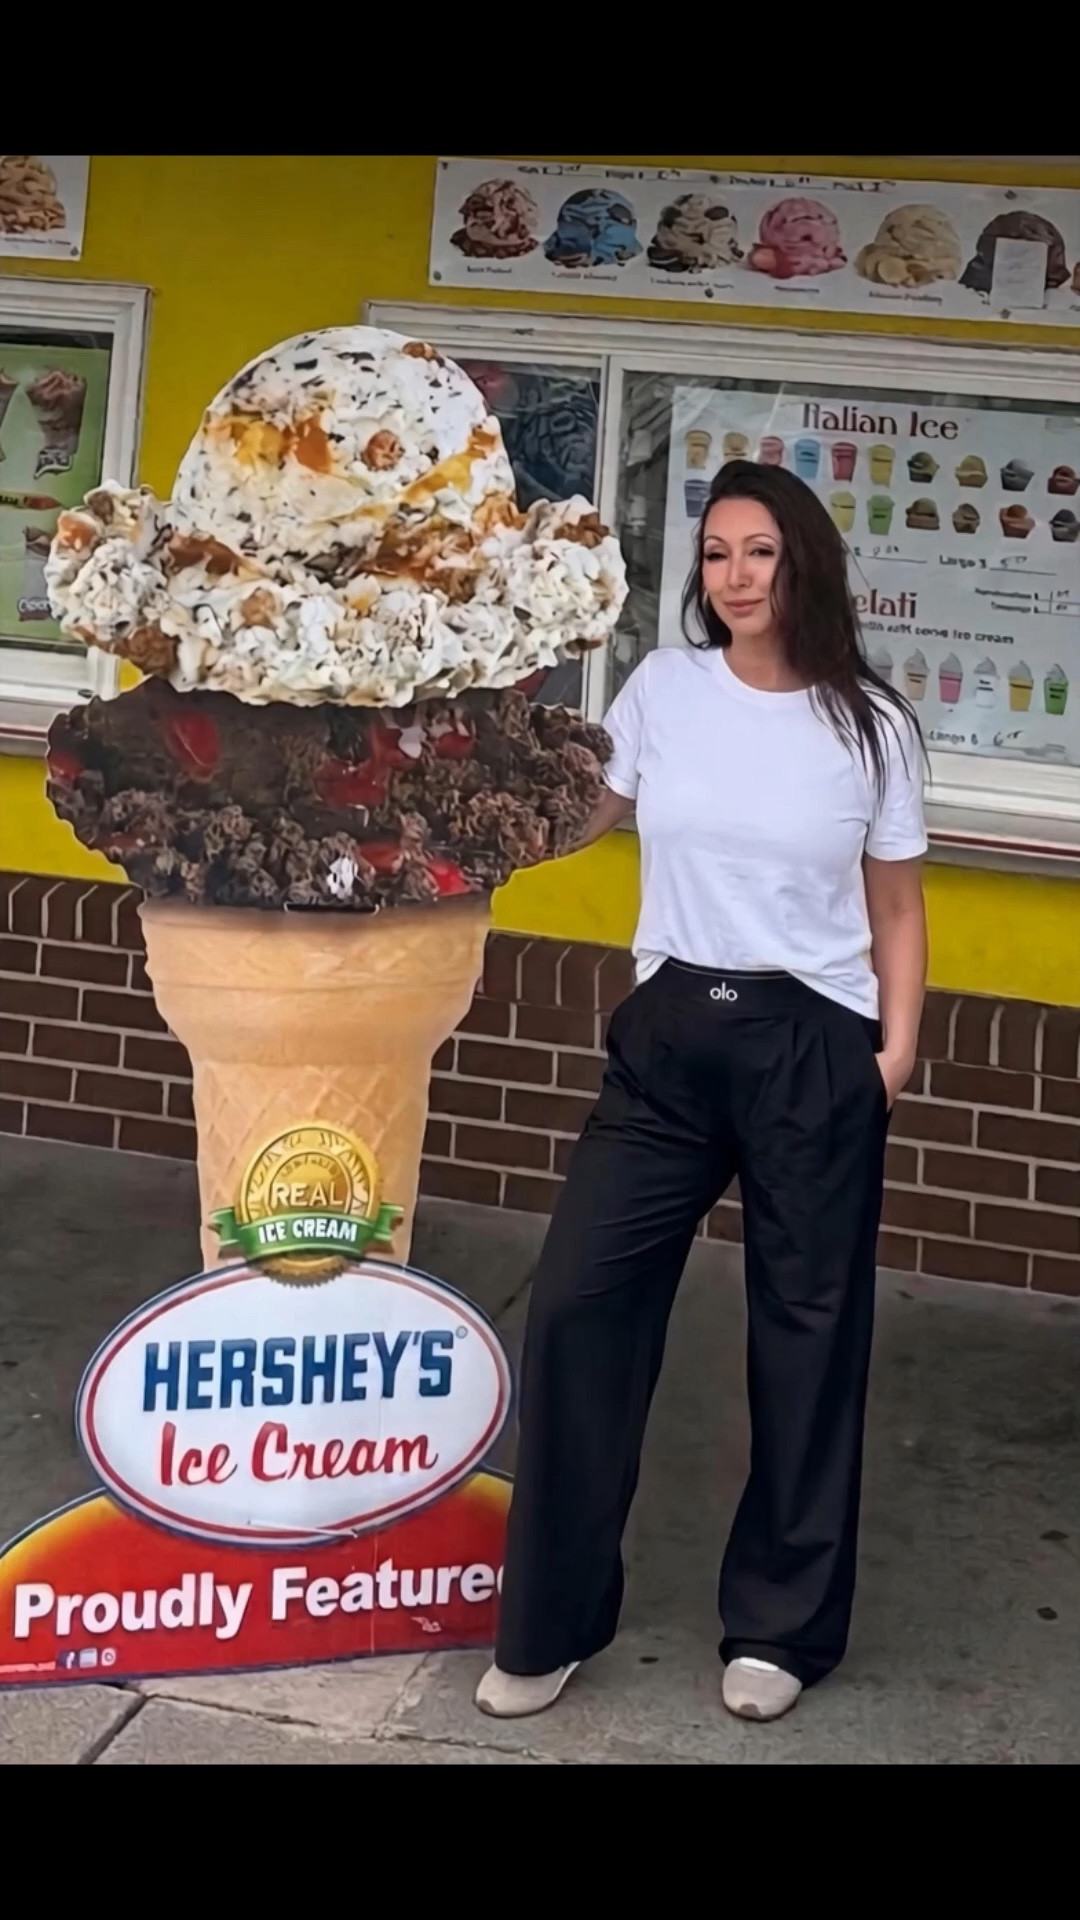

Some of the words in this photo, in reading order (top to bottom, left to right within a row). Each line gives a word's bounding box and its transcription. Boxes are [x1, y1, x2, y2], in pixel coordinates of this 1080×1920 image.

[803, 403, 898, 435] Italian
[909, 410, 959, 440] Ice
[854, 588, 918, 618] elati
[271, 1182, 344, 1209] REAL
[258, 1221, 287, 1244] ICE
[292, 1218, 358, 1243] CREAM
[142, 1329, 455, 1412] HERSHEY'S
[158, 1420, 237, 1486] Ice
[251, 1420, 438, 1483] Cream
[13, 1571, 254, 1640] Proudly
[271, 1556, 505, 1621] Feature
